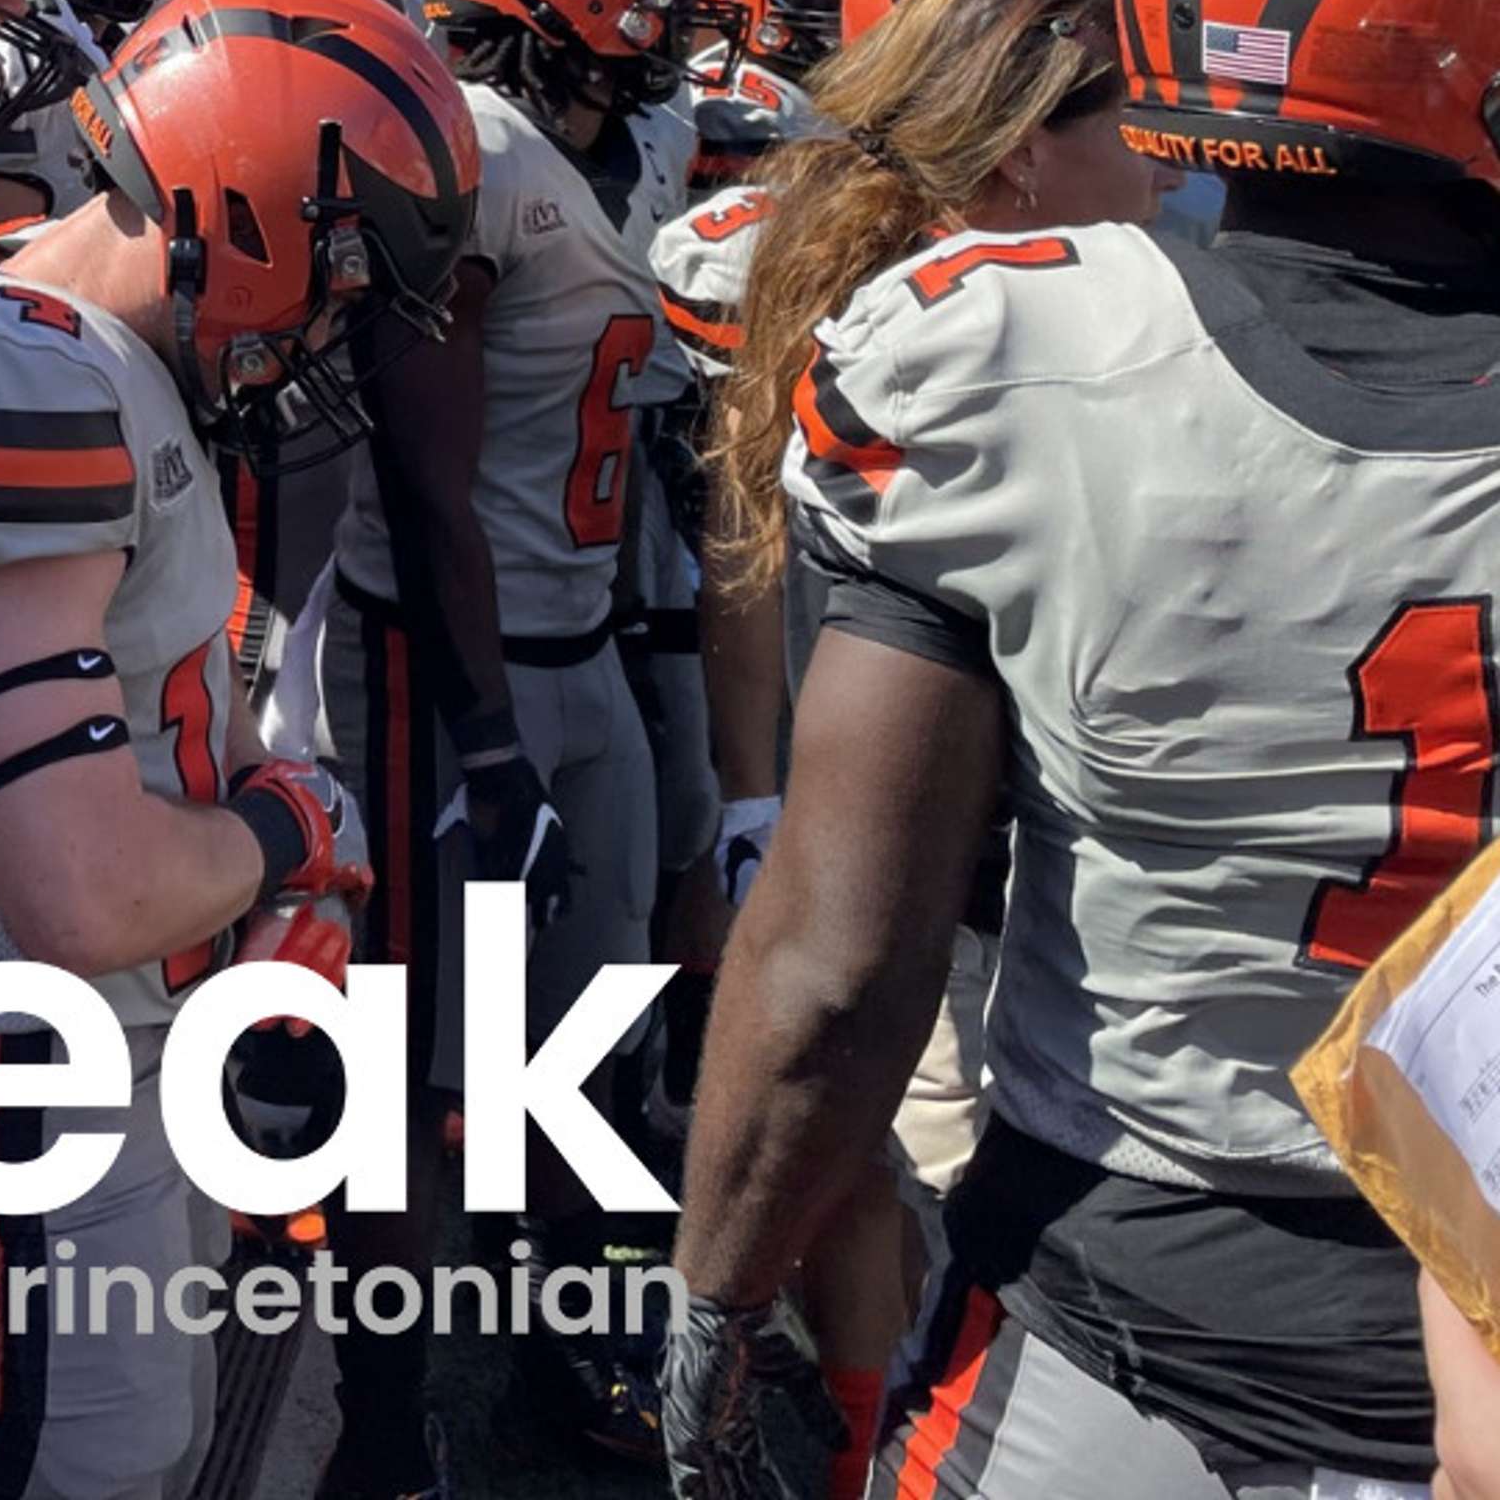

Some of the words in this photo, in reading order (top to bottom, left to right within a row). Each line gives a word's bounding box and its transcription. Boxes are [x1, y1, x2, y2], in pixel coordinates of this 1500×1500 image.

[1202, 137, 1269, 170] FOR
[1275, 143, 1337, 174] ALL
[563, 314, 655, 548] 6
